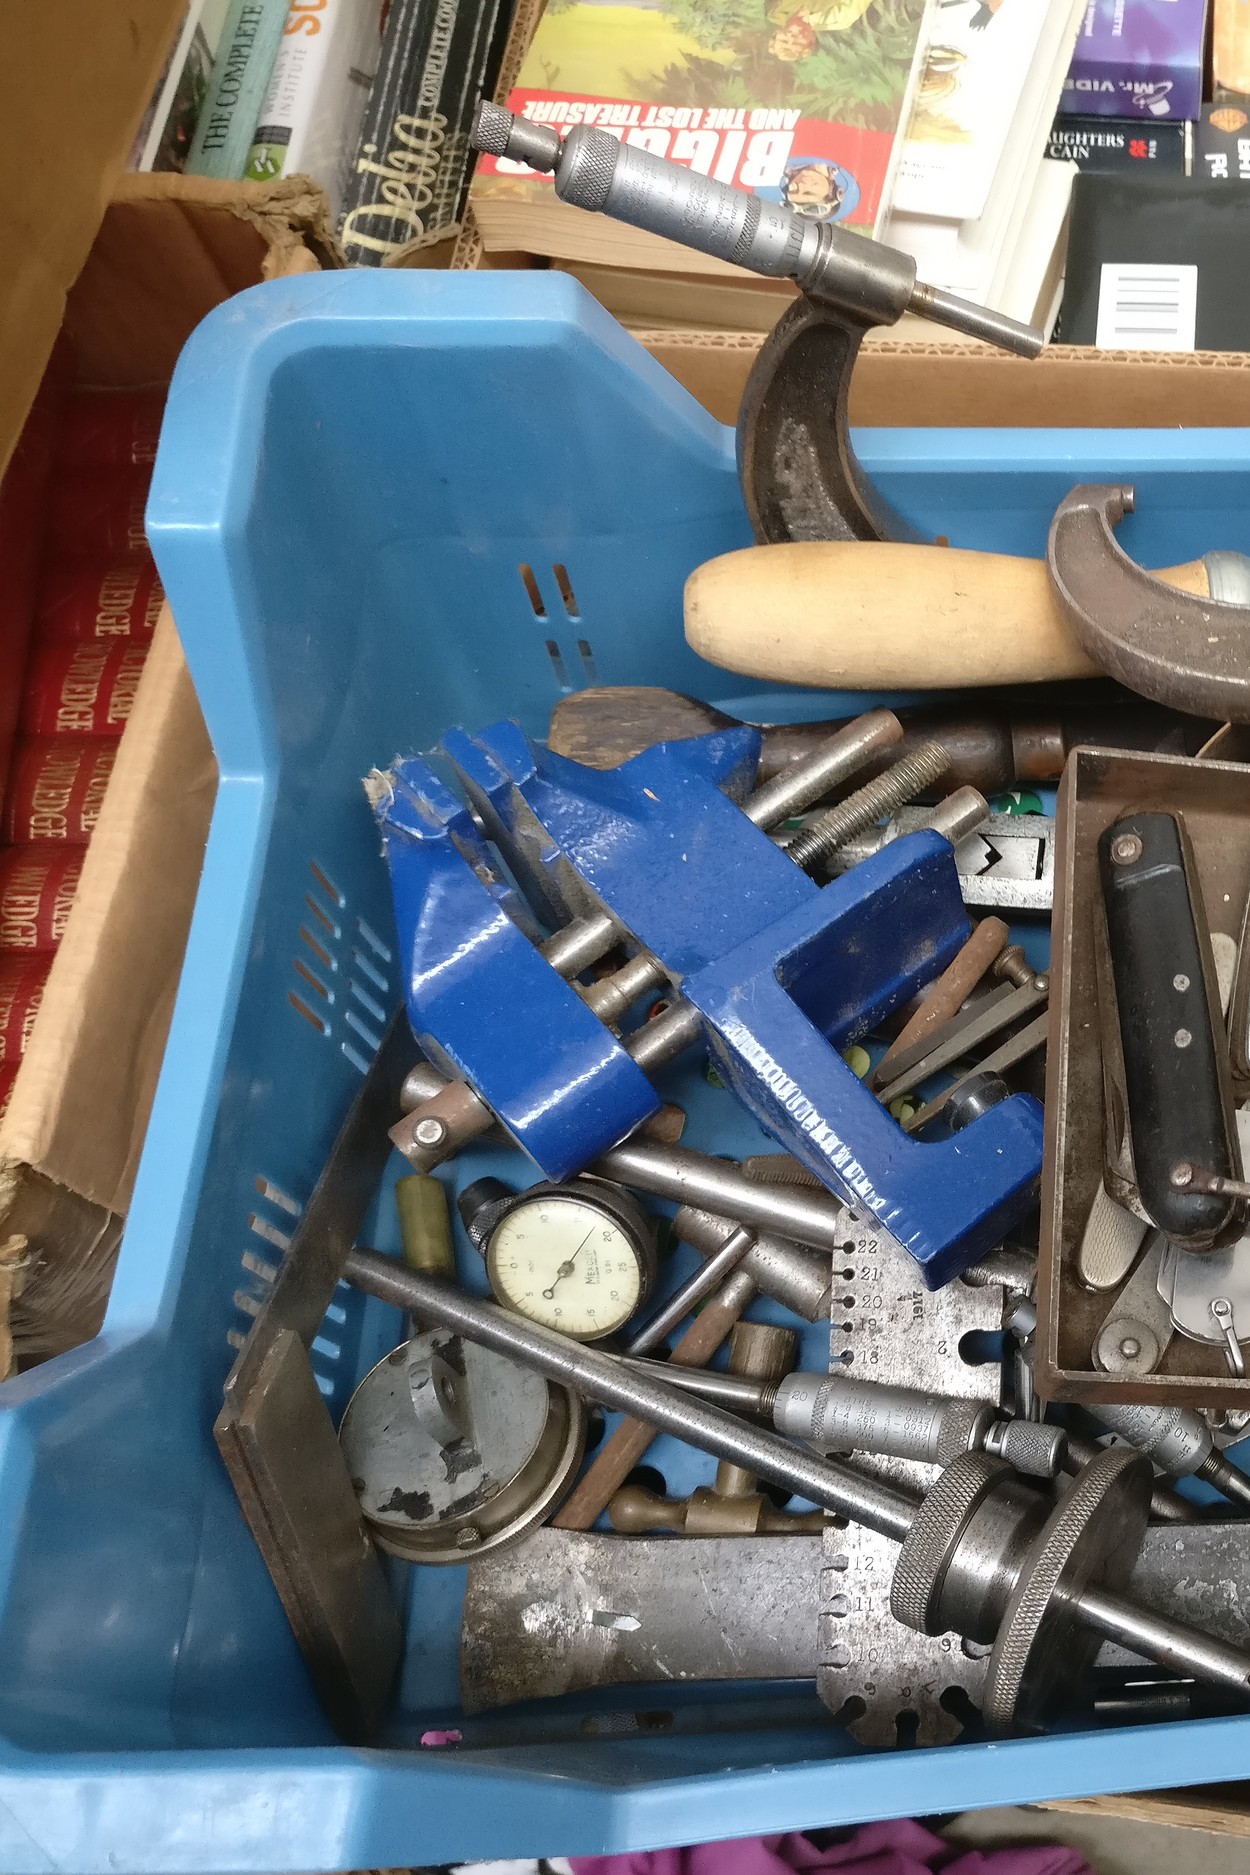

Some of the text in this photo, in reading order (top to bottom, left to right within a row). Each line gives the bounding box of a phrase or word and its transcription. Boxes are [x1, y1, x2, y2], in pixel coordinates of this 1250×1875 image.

[202, 4, 264, 154] THE COMPLETE
[279, 49, 307, 117] INSTITUTE
[1063, 78, 1115, 93] VIDE
[521, 100, 801, 131] AND THE LOST TREASURE
[1050, 146, 1090, 159] CAIN
[342, 113, 448, 252] Delia
[603, 1230, 613, 1243] 20
[857, 1239, 878, 1254] 22
[618, 1261, 628, 1273] 25
[860, 1266, 879, 1281] 21
[862, 1295, 883, 1309] 20
[554, 1308, 563, 1317] 10
[586, 1308, 596, 1318] 15
[859, 1317, 878, 1331] 19
[859, 1350, 879, 1365] 18
[791, 1391, 808, 1402] 20
[1173, 1427, 1190, 1443] 10
[854, 1555, 875, 1572] 12
[855, 1597, 875, 1612] 11
[858, 1646, 878, 1662] 10
